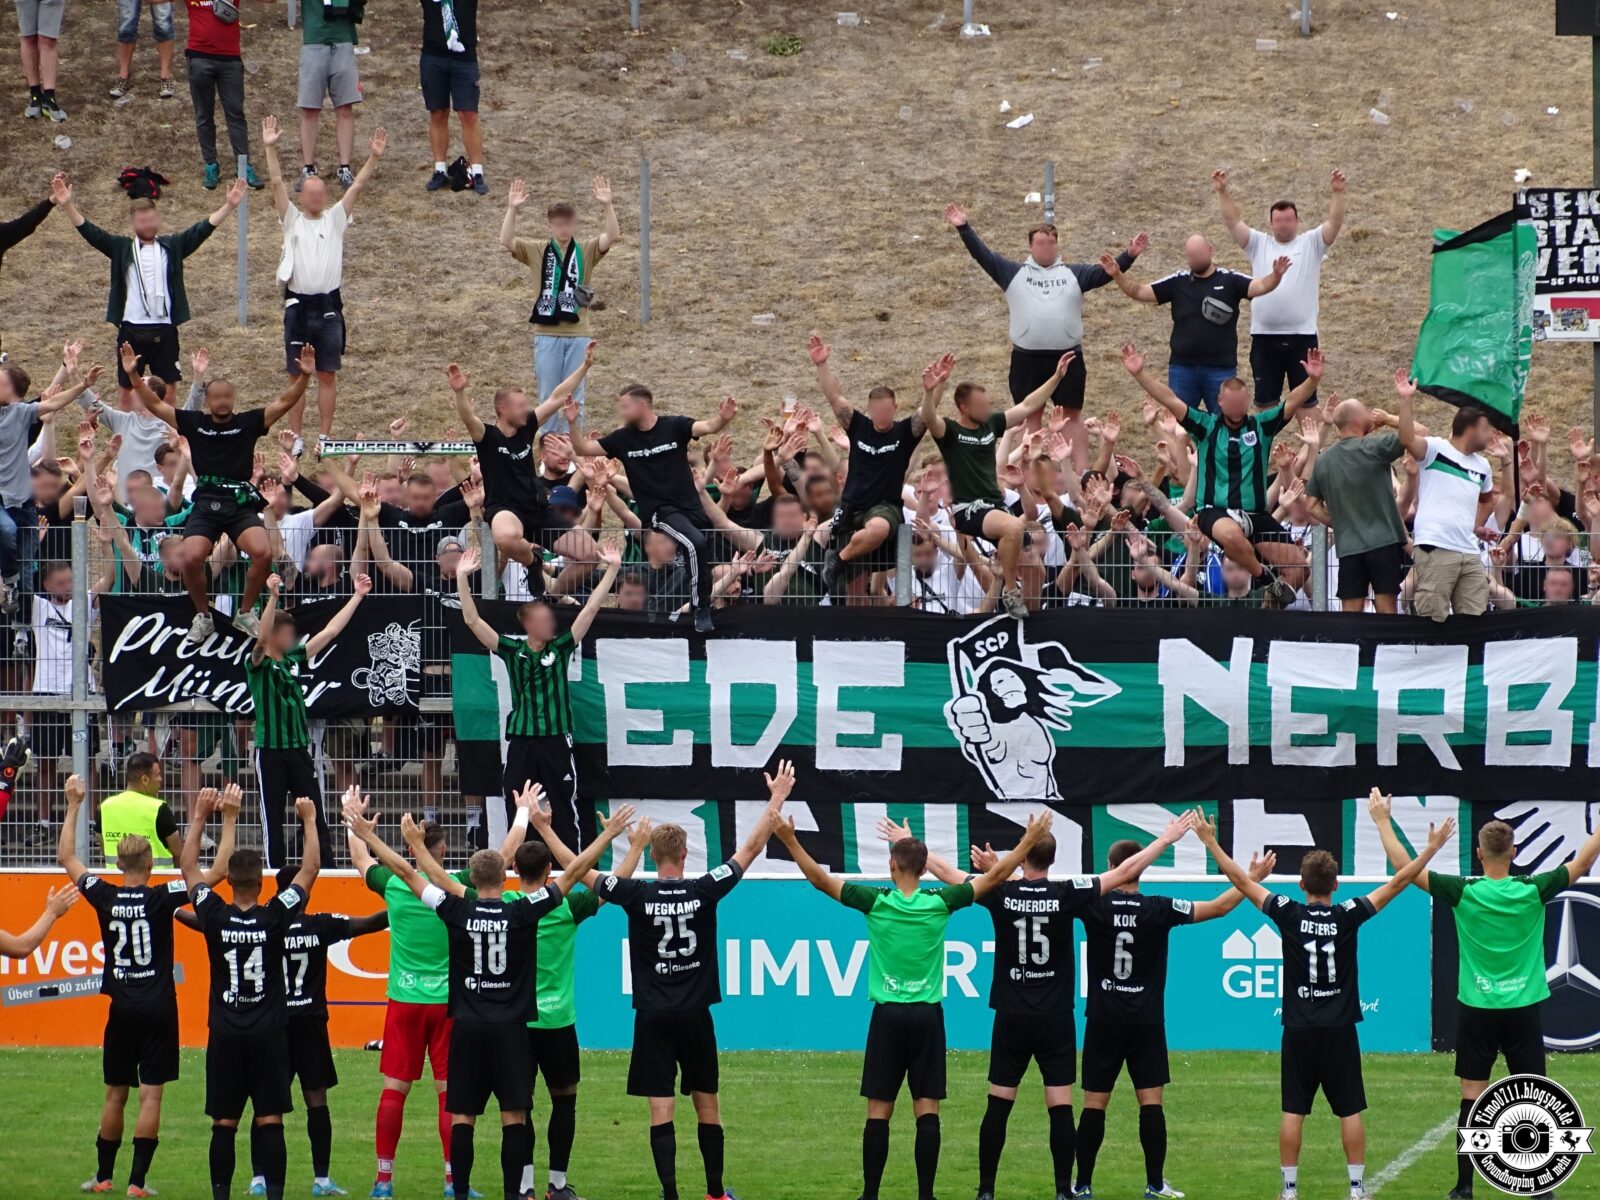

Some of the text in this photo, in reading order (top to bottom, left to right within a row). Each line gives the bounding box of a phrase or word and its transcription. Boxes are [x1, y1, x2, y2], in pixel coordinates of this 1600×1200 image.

[974, 631, 1009, 658] SCP
[111, 904, 146, 918] GROTE
[645, 899, 701, 916] WEGKAMP
[1003, 896, 1060, 913] SCHERDER
[466, 918, 509, 933] LORENZ
[1113, 914, 1137, 927] KOK
[1300, 919, 1338, 936] DETERS
[109, 919, 152, 967] 20
[221, 929, 267, 943] WOOTEN
[653, 913, 697, 959] 25
[1013, 916, 1050, 965] 15
[468, 932, 507, 975] 18
[1113, 931, 1134, 980] 6
[1303, 939, 1336, 984] 11
[223, 946, 266, 993] 14
[8, 986, 33, 1001] Über
